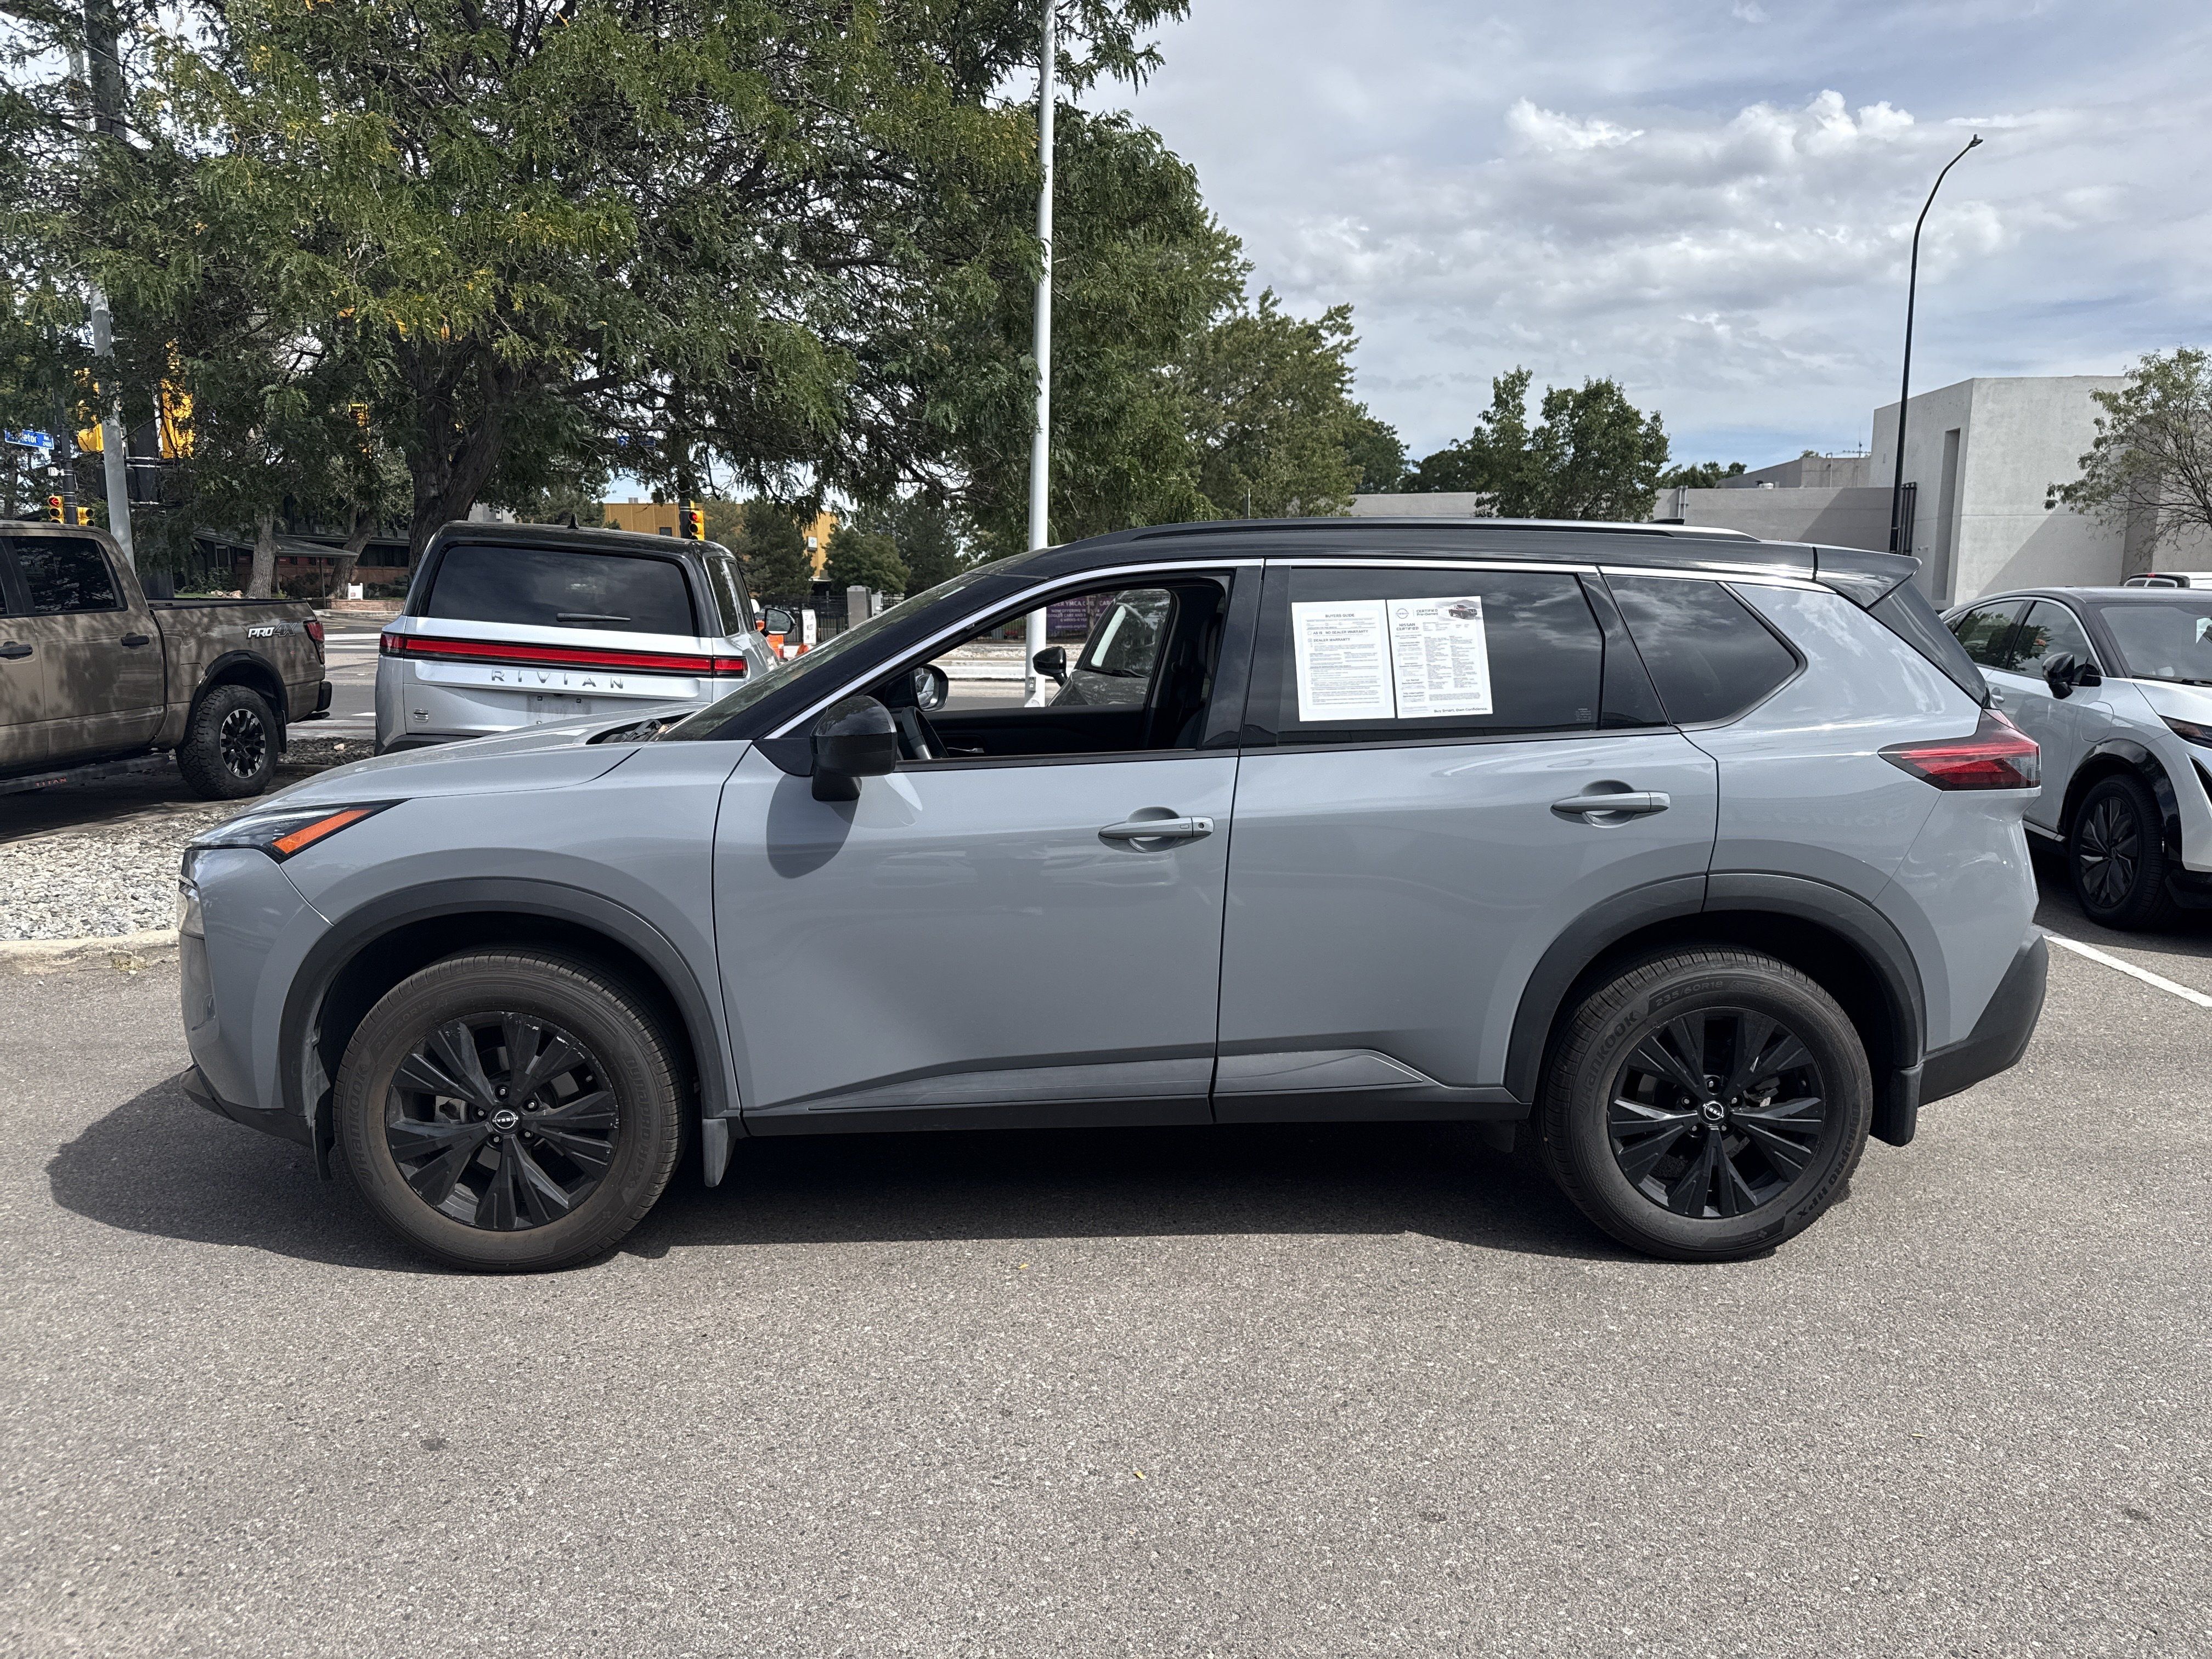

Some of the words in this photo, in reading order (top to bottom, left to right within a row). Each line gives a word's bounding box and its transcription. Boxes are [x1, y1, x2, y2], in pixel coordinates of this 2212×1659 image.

[492, 670, 624, 689] RIVIAN
[35, 777, 67, 787] TITAN
[1656, 981, 1723, 1007] 235/60R18
